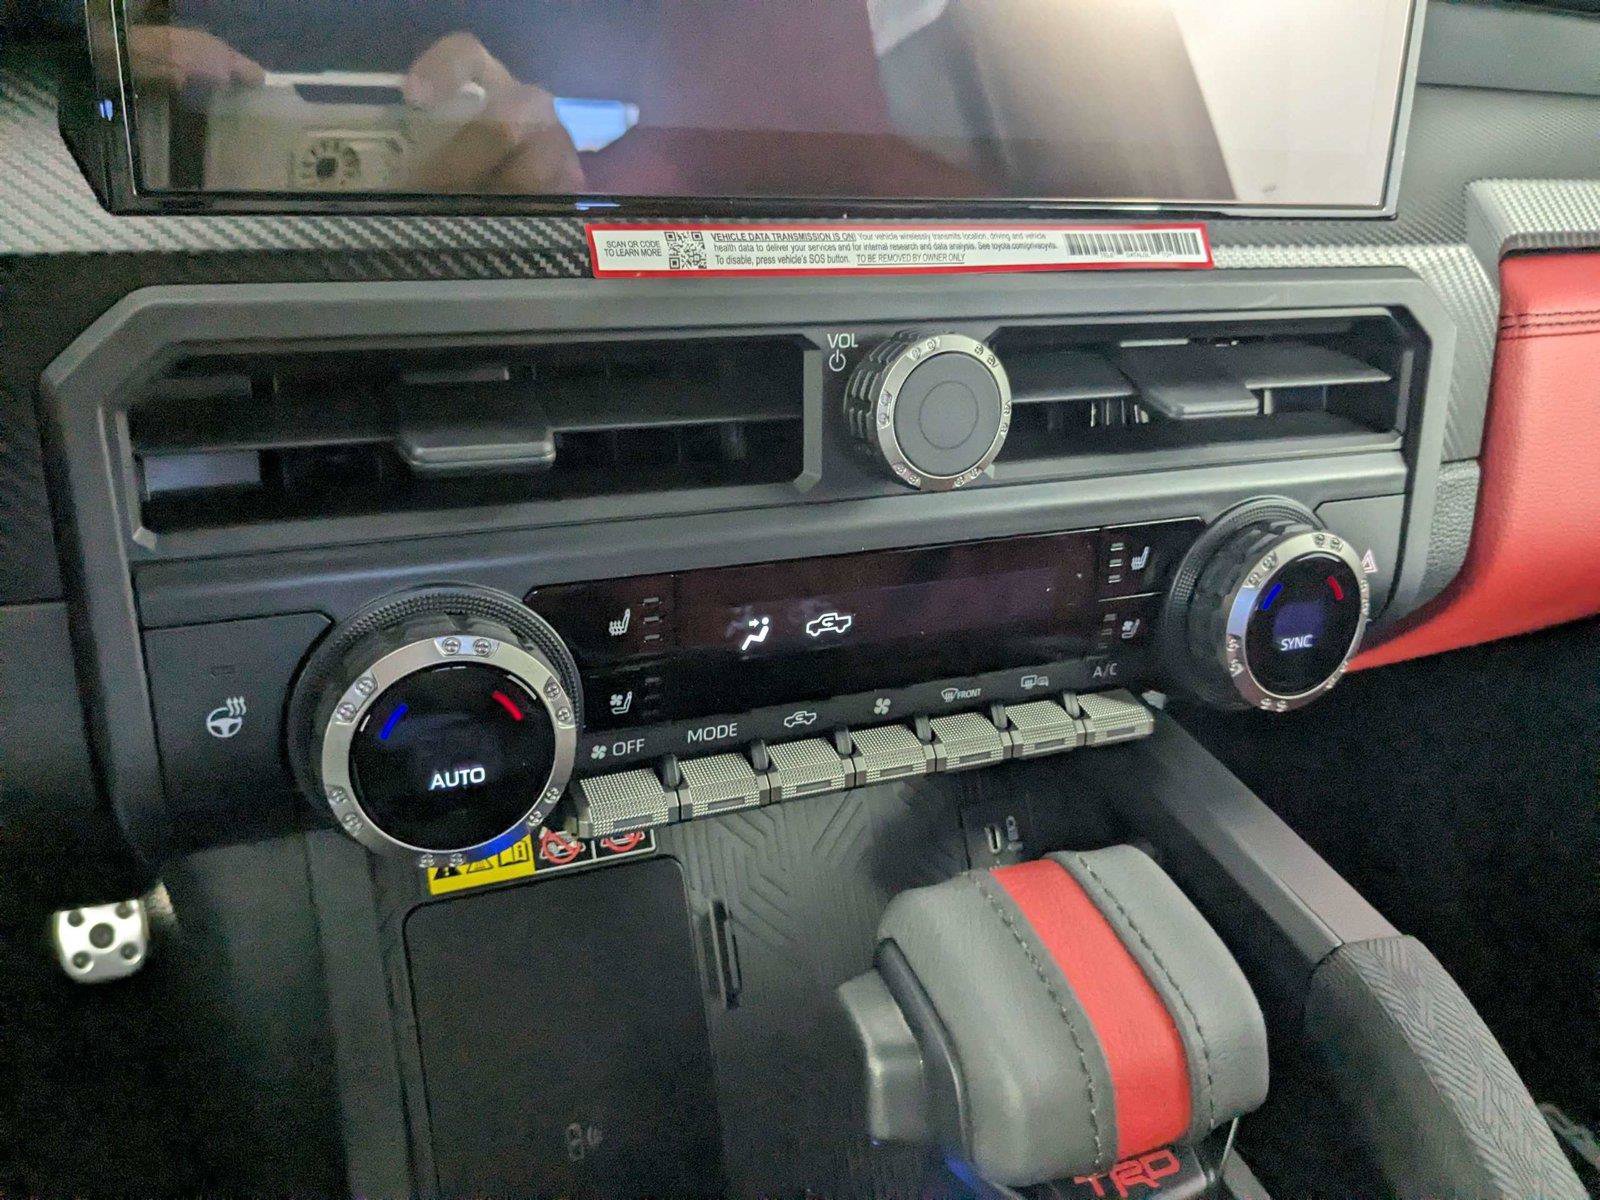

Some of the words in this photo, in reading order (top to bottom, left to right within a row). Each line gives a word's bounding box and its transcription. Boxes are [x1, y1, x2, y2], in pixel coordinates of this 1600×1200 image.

[606, 240, 627, 248] SCAN
[640, 240, 660, 248] CODE
[710, 232, 747, 241] VEHICLE
[748, 232, 770, 241] DATA
[771, 232, 831, 241] TRANSMISSION
[833, 232, 841, 241] IS
[857, 232, 873, 240] Your
[874, 232, 898, 240] vehicle
[900, 232, 931, 241] wirelessly
[932, 232, 960, 240] transmits
[990, 232, 1011, 241] driving
[1012, 232, 1024, 240] and
[1025, 232, 1047, 240] vehicle
[604, 248, 615, 257] TO
[616, 248, 640, 257] LEARN
[640, 248, 662, 257] MORE
[714, 243, 737, 252] health
[738, 243, 755, 252] data
[756, 243, 764, 252] to
[766, 243, 789, 252] deliver
[790, 244, 806, 254] your
[808, 243, 836, 252] services
[838, 243, 851, 251] and
[852, 243, 861, 251] for
[863, 243, 889, 251] internal
[890, 243, 919, 251] research
[920, 243, 932, 251] and
[933, 242, 948, 250] data
[949, 242, 977, 251] analysis.
[978, 242, 991, 250] See
[715, 254, 725, 265] To
[726, 255, 754, 266] disable,
[755, 256, 776, 266] press
[778, 254, 807, 264] vehicle's
[809, 254, 826, 264] SOS
[827, 254, 849, 264] button.
[857, 254, 866, 263] TO
[867, 254, 877, 262] BE
[879, 253, 911, 262] REMOVED
[912, 253, 921, 262] BY
[922, 253, 948, 262] OWNER
[948, 253, 965, 262] ONLY
[827, 333, 859, 349] VOL
[1280, 634, 1314, 651] SYNC
[1092, 662, 1119, 678] A/C
[956, 688, 982, 700] FRONT
[687, 722, 738, 744] MODE
[612, 738, 645, 756] OFF
[429, 766, 486, 791] AUTO
[1073, 1149, 1181, 1199] TRD
